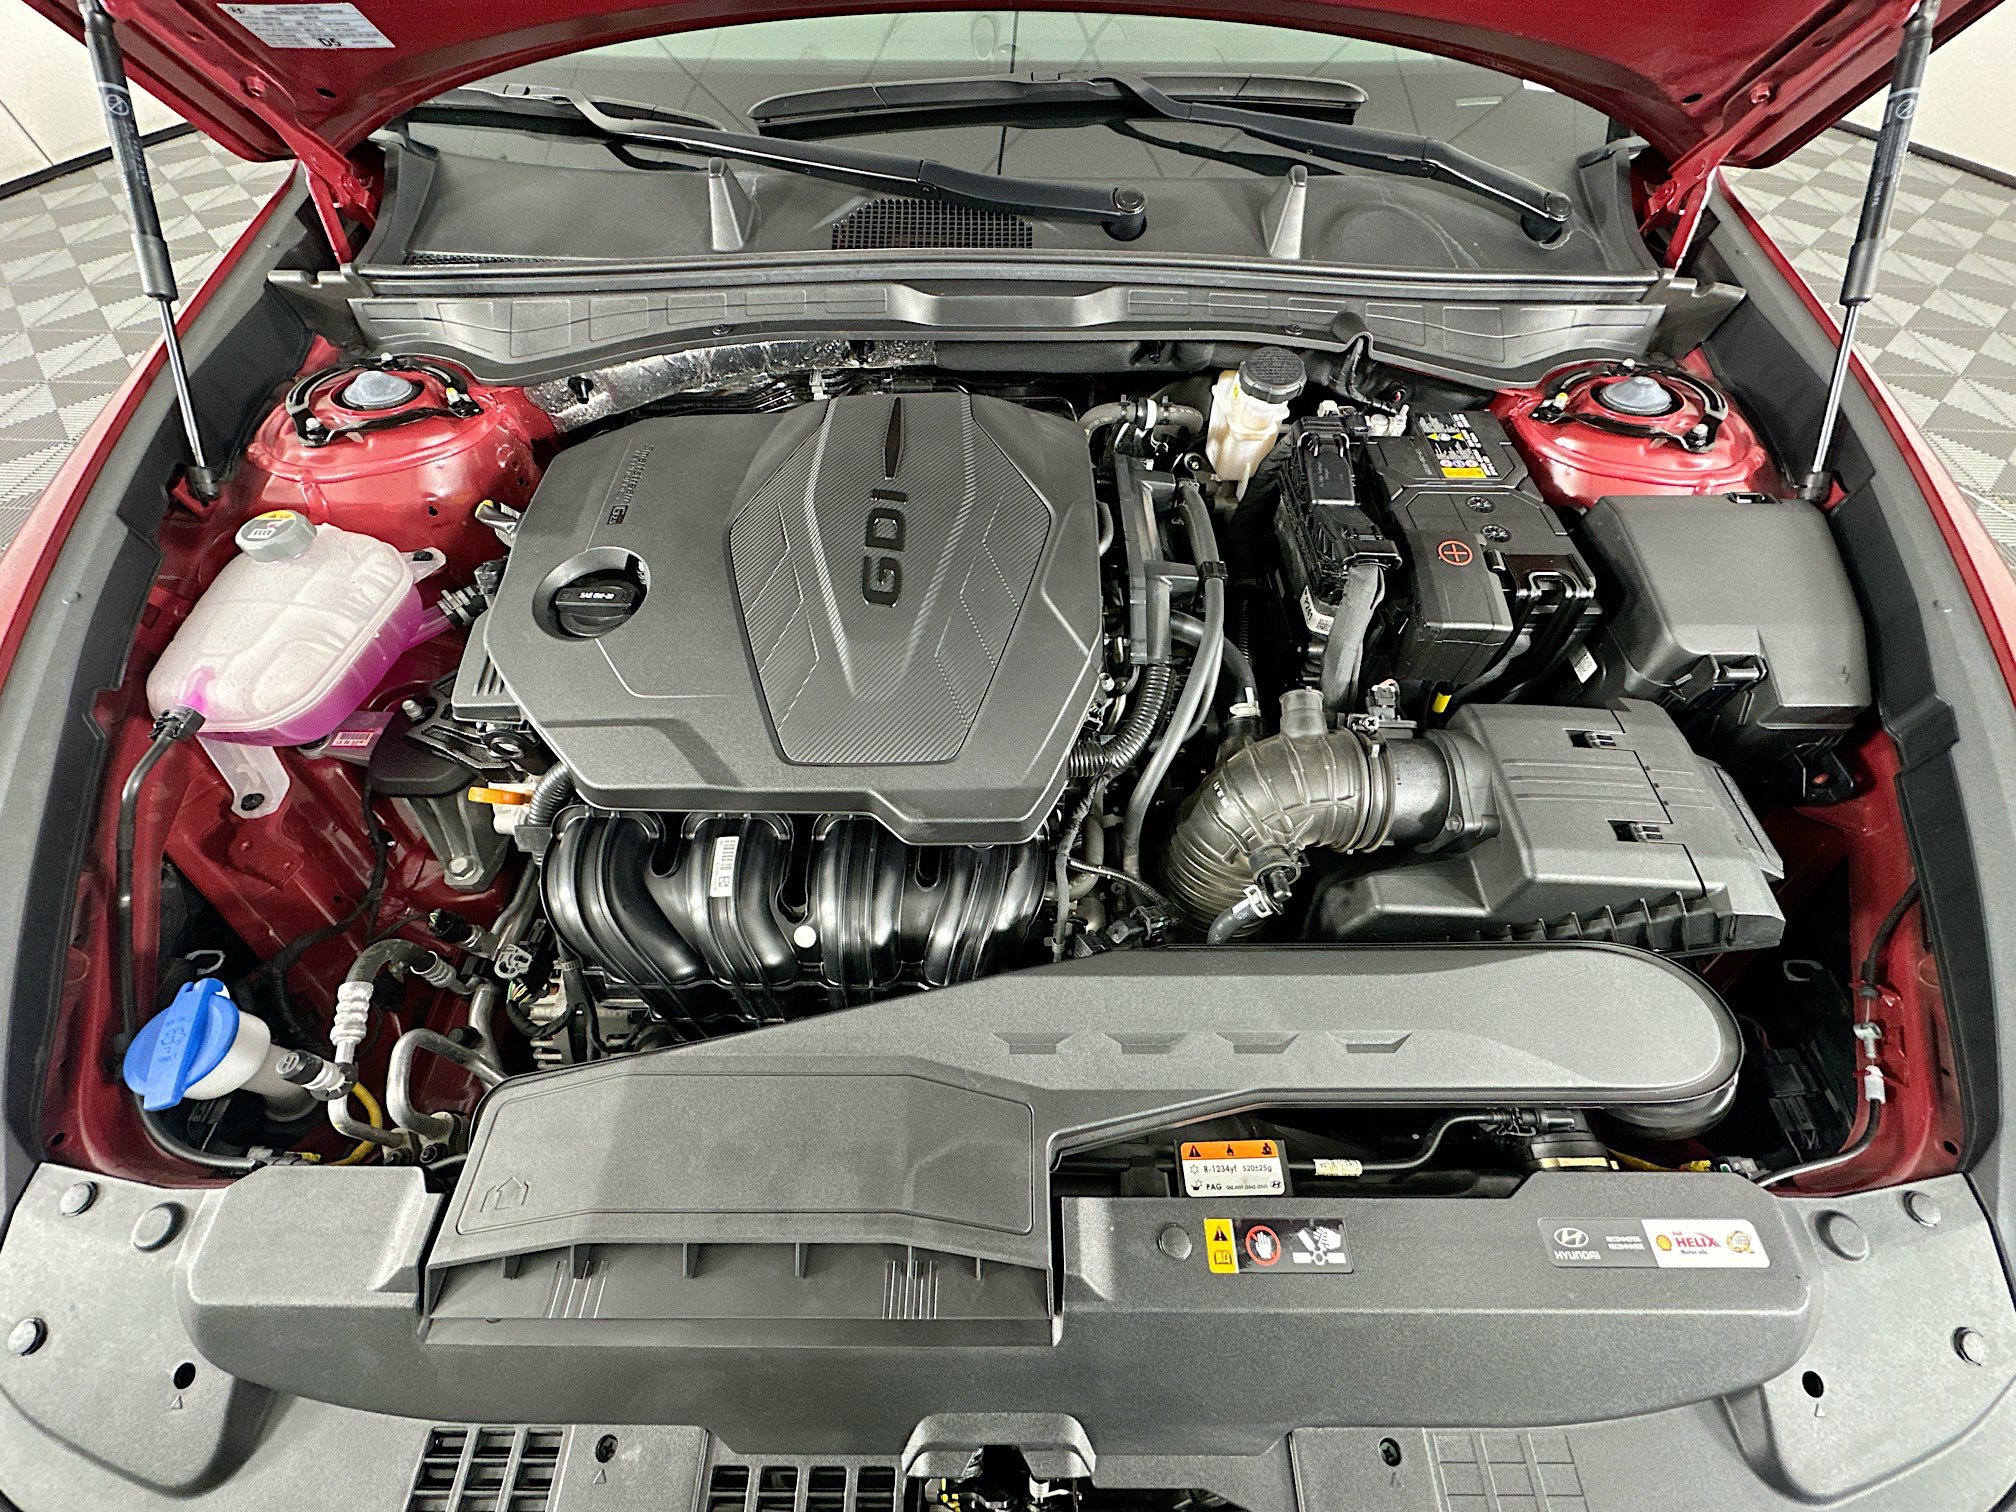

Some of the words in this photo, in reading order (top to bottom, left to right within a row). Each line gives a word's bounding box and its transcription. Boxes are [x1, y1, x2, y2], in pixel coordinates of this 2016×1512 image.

[623, 444, 654, 503] Smartstream
[862, 488, 907, 607] GDI
[1203, 1165, 1237, 1174] R-1234yf
[1243, 1164, 1273, 1173] 520±25g
[1206, 1183, 1222, 1191] PAG
[1675, 1236, 1721, 1248] HELIX
[1553, 1250, 1601, 1260] HYUNDAI
